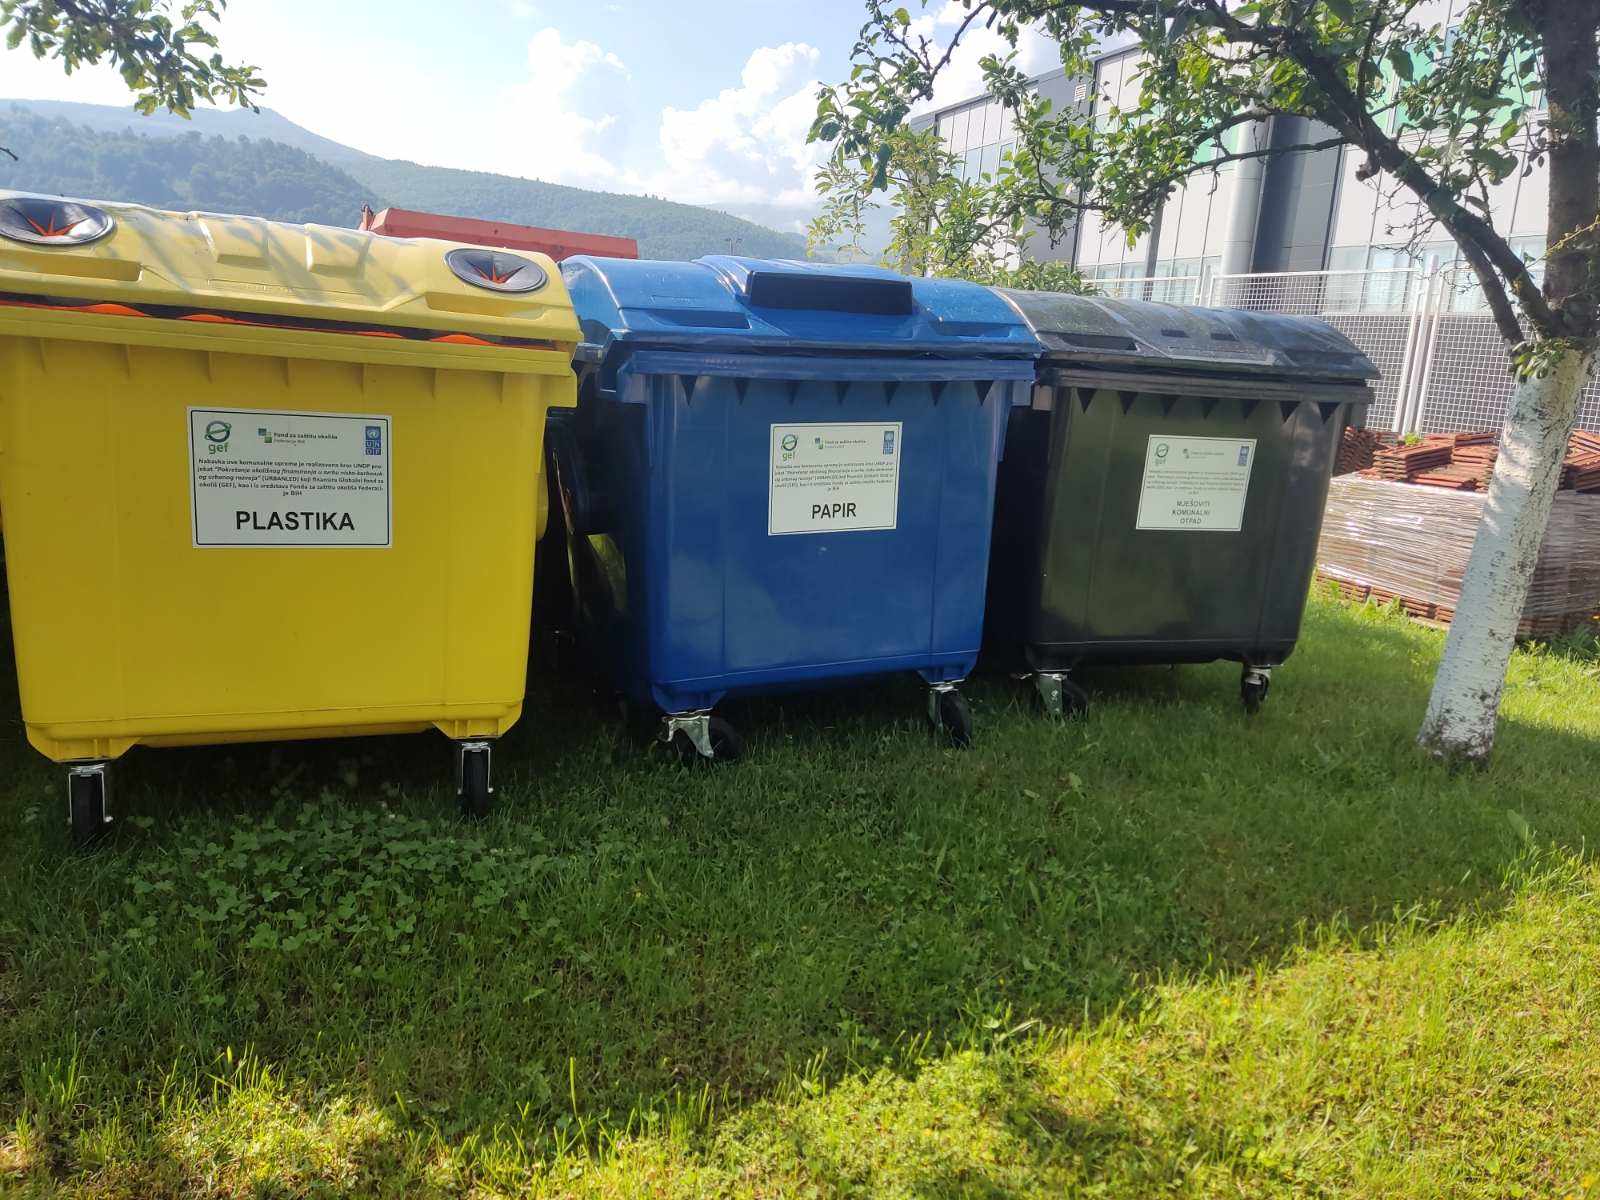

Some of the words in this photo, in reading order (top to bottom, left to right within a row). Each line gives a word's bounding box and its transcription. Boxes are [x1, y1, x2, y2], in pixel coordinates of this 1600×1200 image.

[208, 442, 229, 454] gef
[782, 452, 796, 462] gef
[811, 502, 857, 520] PAPIR
[236, 511, 356, 531] PLASTIKA
